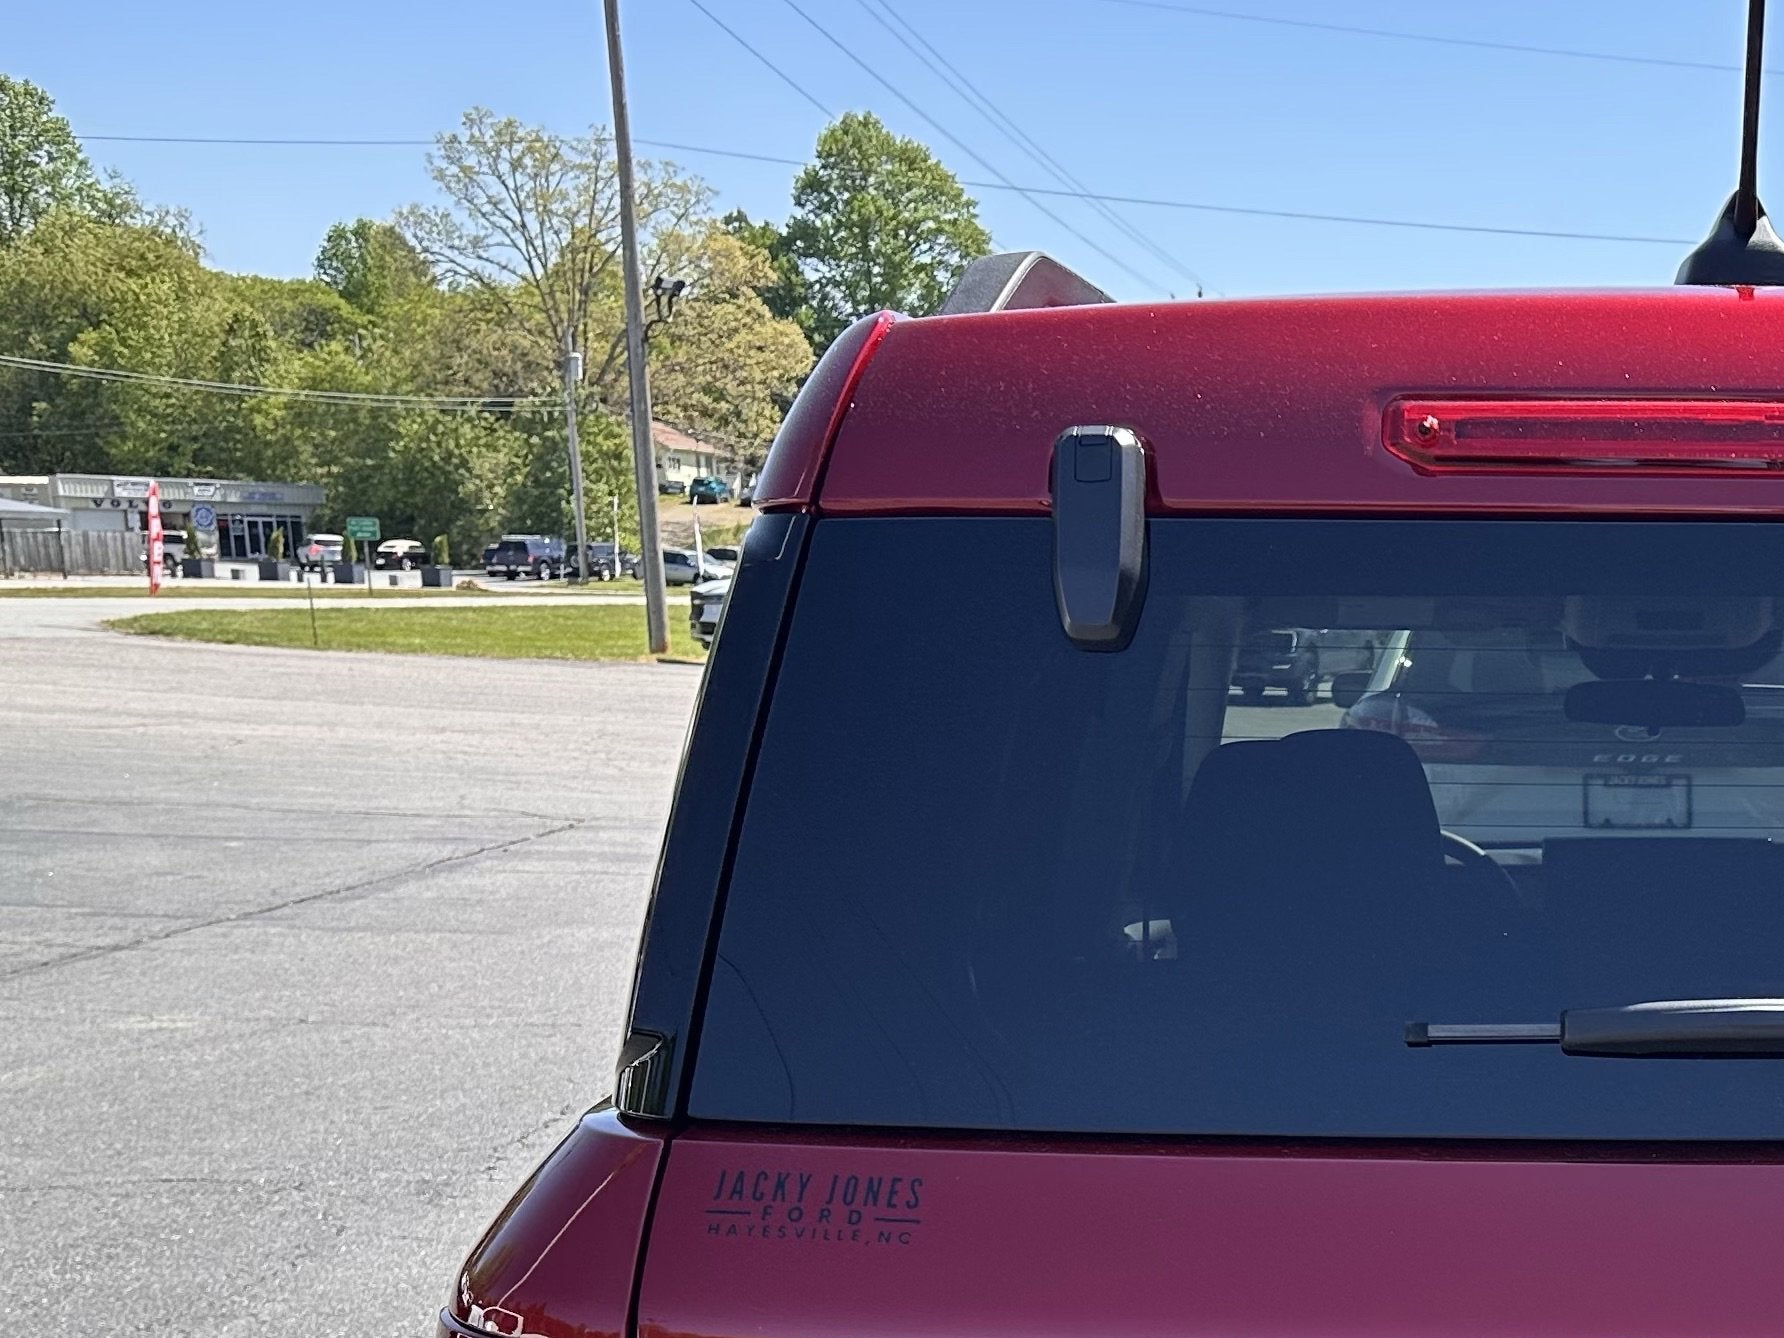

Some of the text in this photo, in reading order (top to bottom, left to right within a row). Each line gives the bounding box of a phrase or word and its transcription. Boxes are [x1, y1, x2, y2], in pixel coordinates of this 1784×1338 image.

[91, 498, 172, 509] VOLO
[713, 1169, 923, 1210] JACKY JONES
[761, 1205, 863, 1225] FORD
